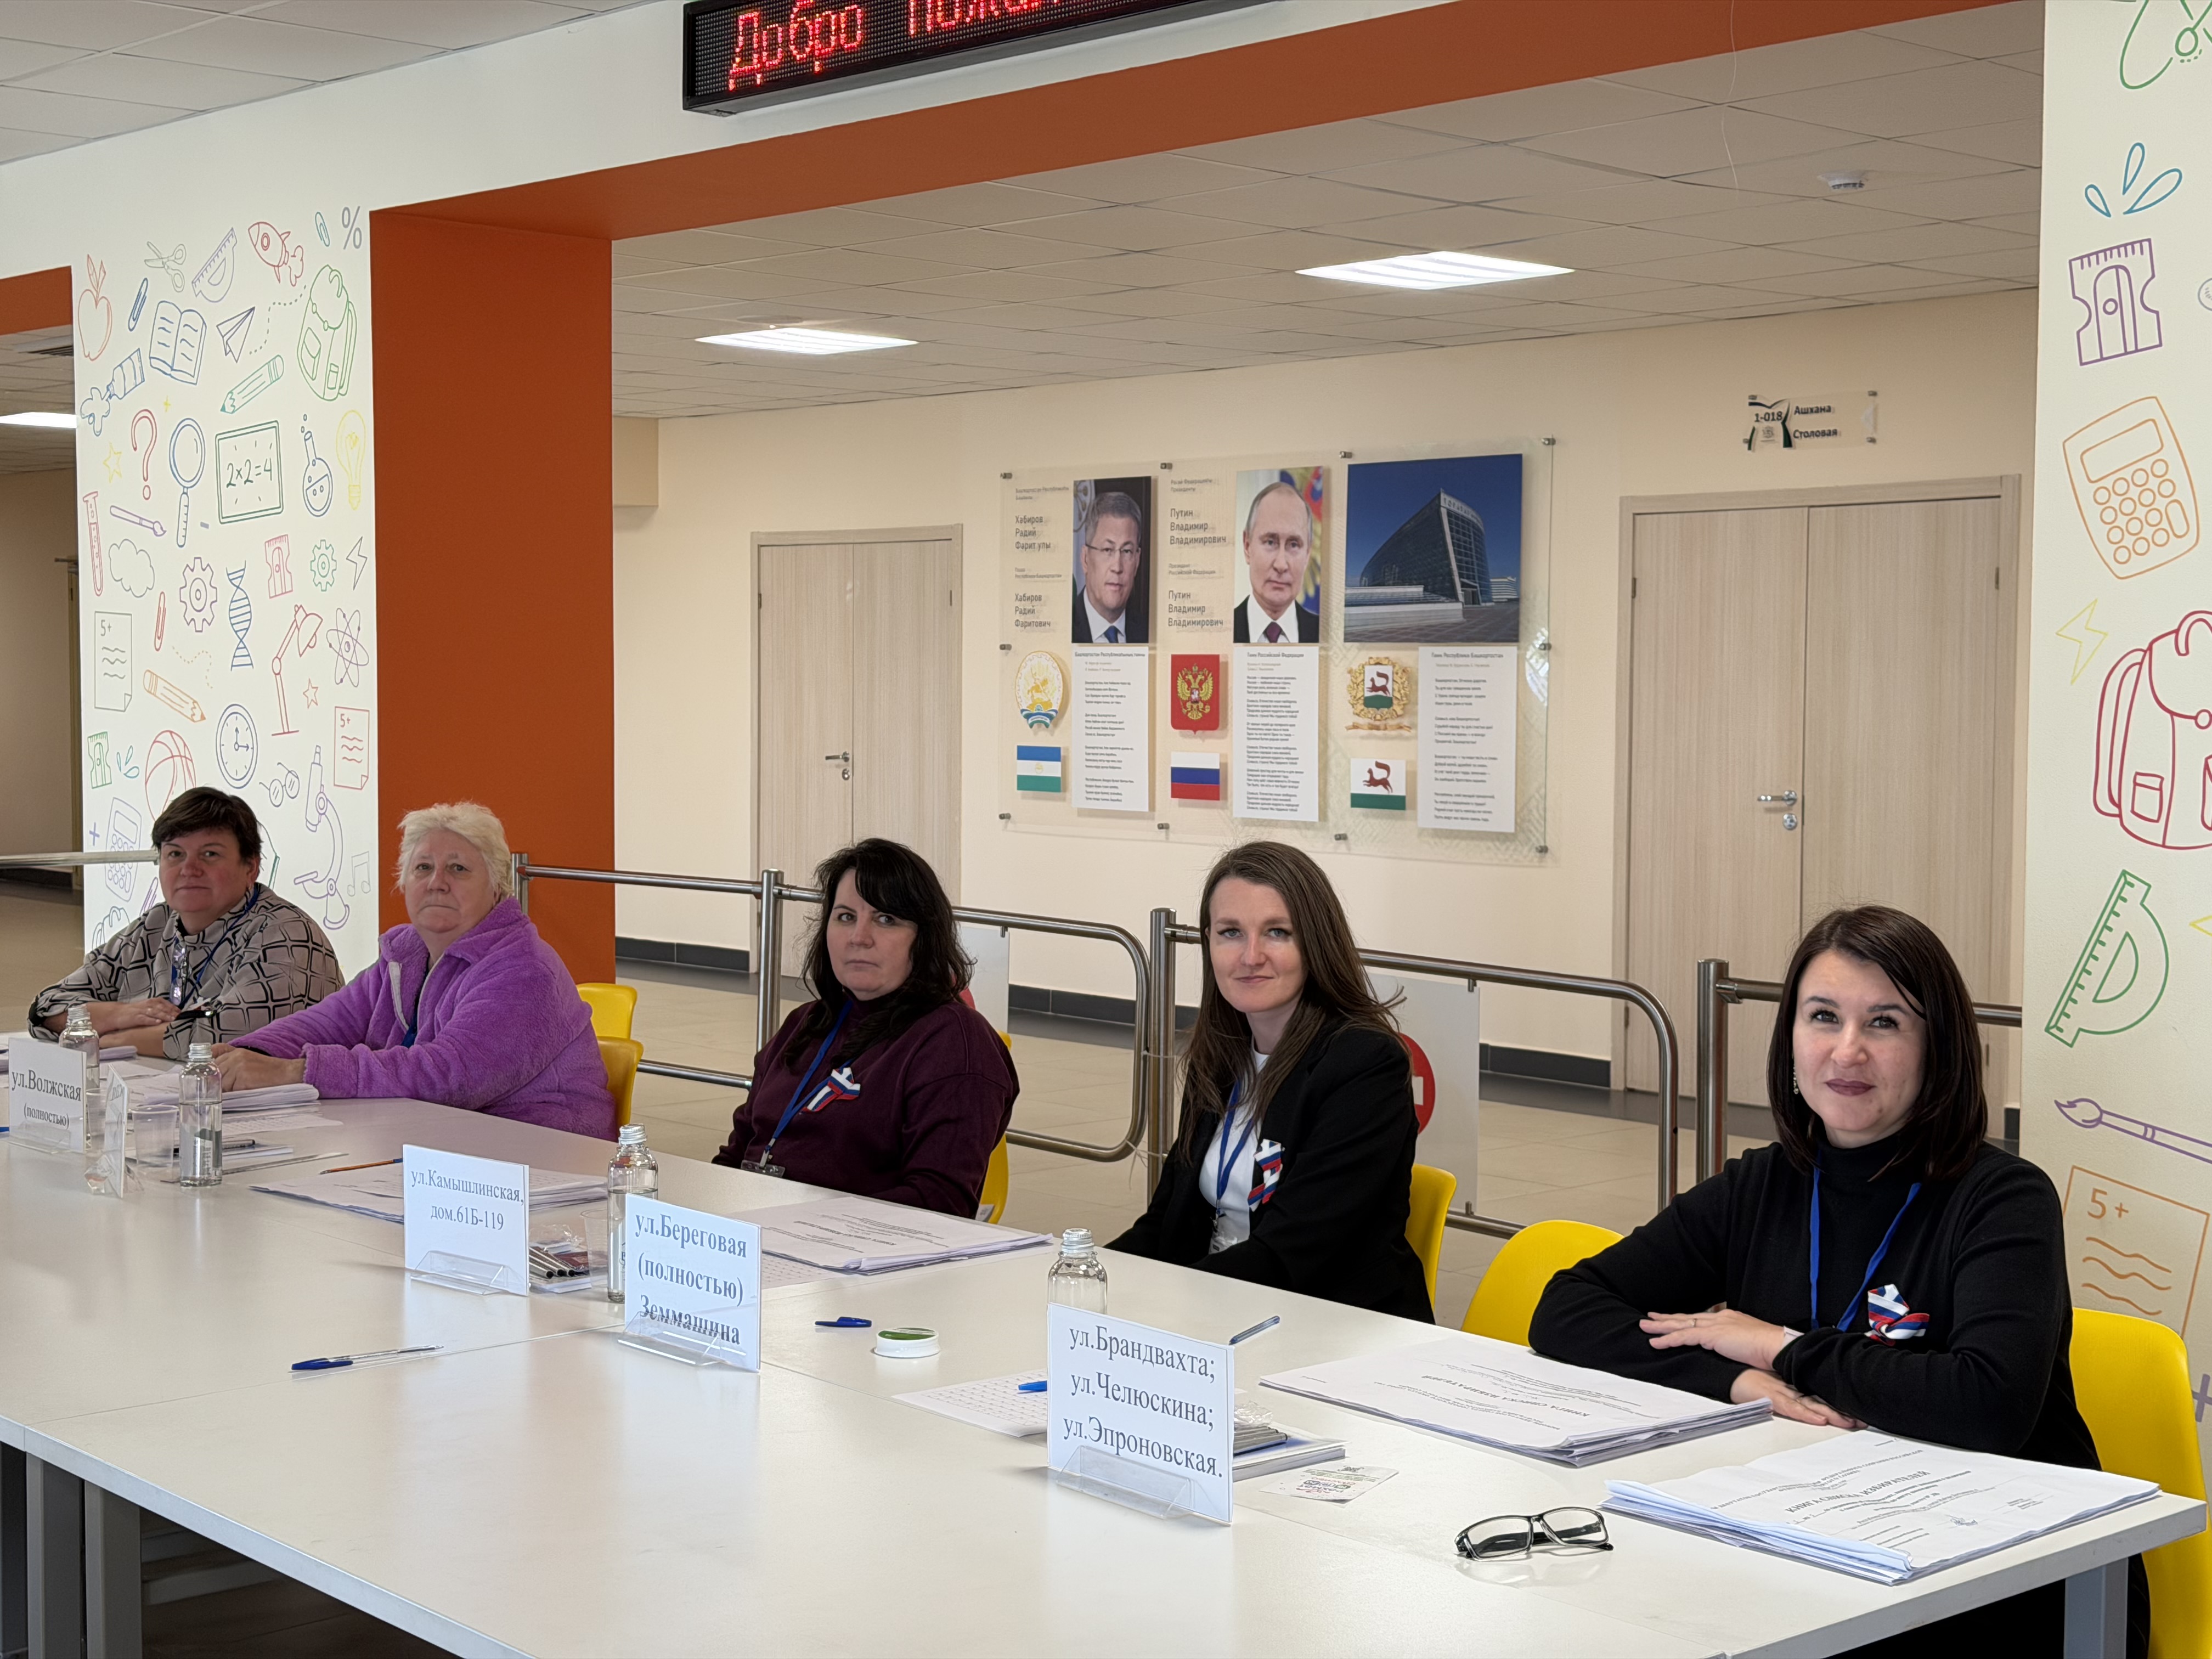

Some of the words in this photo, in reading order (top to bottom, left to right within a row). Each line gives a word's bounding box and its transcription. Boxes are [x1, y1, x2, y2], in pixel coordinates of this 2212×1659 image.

[729, 0, 864, 92] Добро
[1794, 405, 1832, 415] Ашхана
[1754, 411, 1783, 422] 1-018
[1793, 428, 1838, 439] Столовая
[1170, 508, 1193, 520] Путин
[1015, 515, 1043, 525] Хабиров
[1015, 527, 1036, 537] Радий
[1170, 522, 1208, 532] Владимир
[1015, 541, 1036, 551] Фарит
[1038, 542, 1051, 551] улы
[1170, 535, 1226, 546] Владимирович
[1015, 593, 1042, 604] Хабиров
[1169, 590, 1190, 601] Путин
[1015, 605, 1035, 615] Радий
[1169, 604, 1205, 614] Владимир
[1014, 619, 1051, 629] Фаритович
[1168, 617, 1223, 628] Владимирович
[12, 1069, 81, 1102] ул.Волжская
[24, 1103, 70, 1130] (полностью)
[411, 1168, 524, 1205] ул.Камышлинская,
[430, 1205, 504, 1231] дом.61Б-119
[635, 1212, 747, 1259] ул.Береговая
[637, 1253, 744, 1306] (полностью)
[640, 1294, 741, 1345] Земмашина
[1069, 1325, 1216, 1383] ул.Брандвахта;
[1071, 1372, 1214, 1432] ул.Челюскина;
[1063, 1415, 1223, 1478] ул.Эпроновская.
[1785, 1499, 1822, 1513] КНИГА
[1860, 1470, 1931, 1496] ИЗБИРАТЕЛЕЙ
